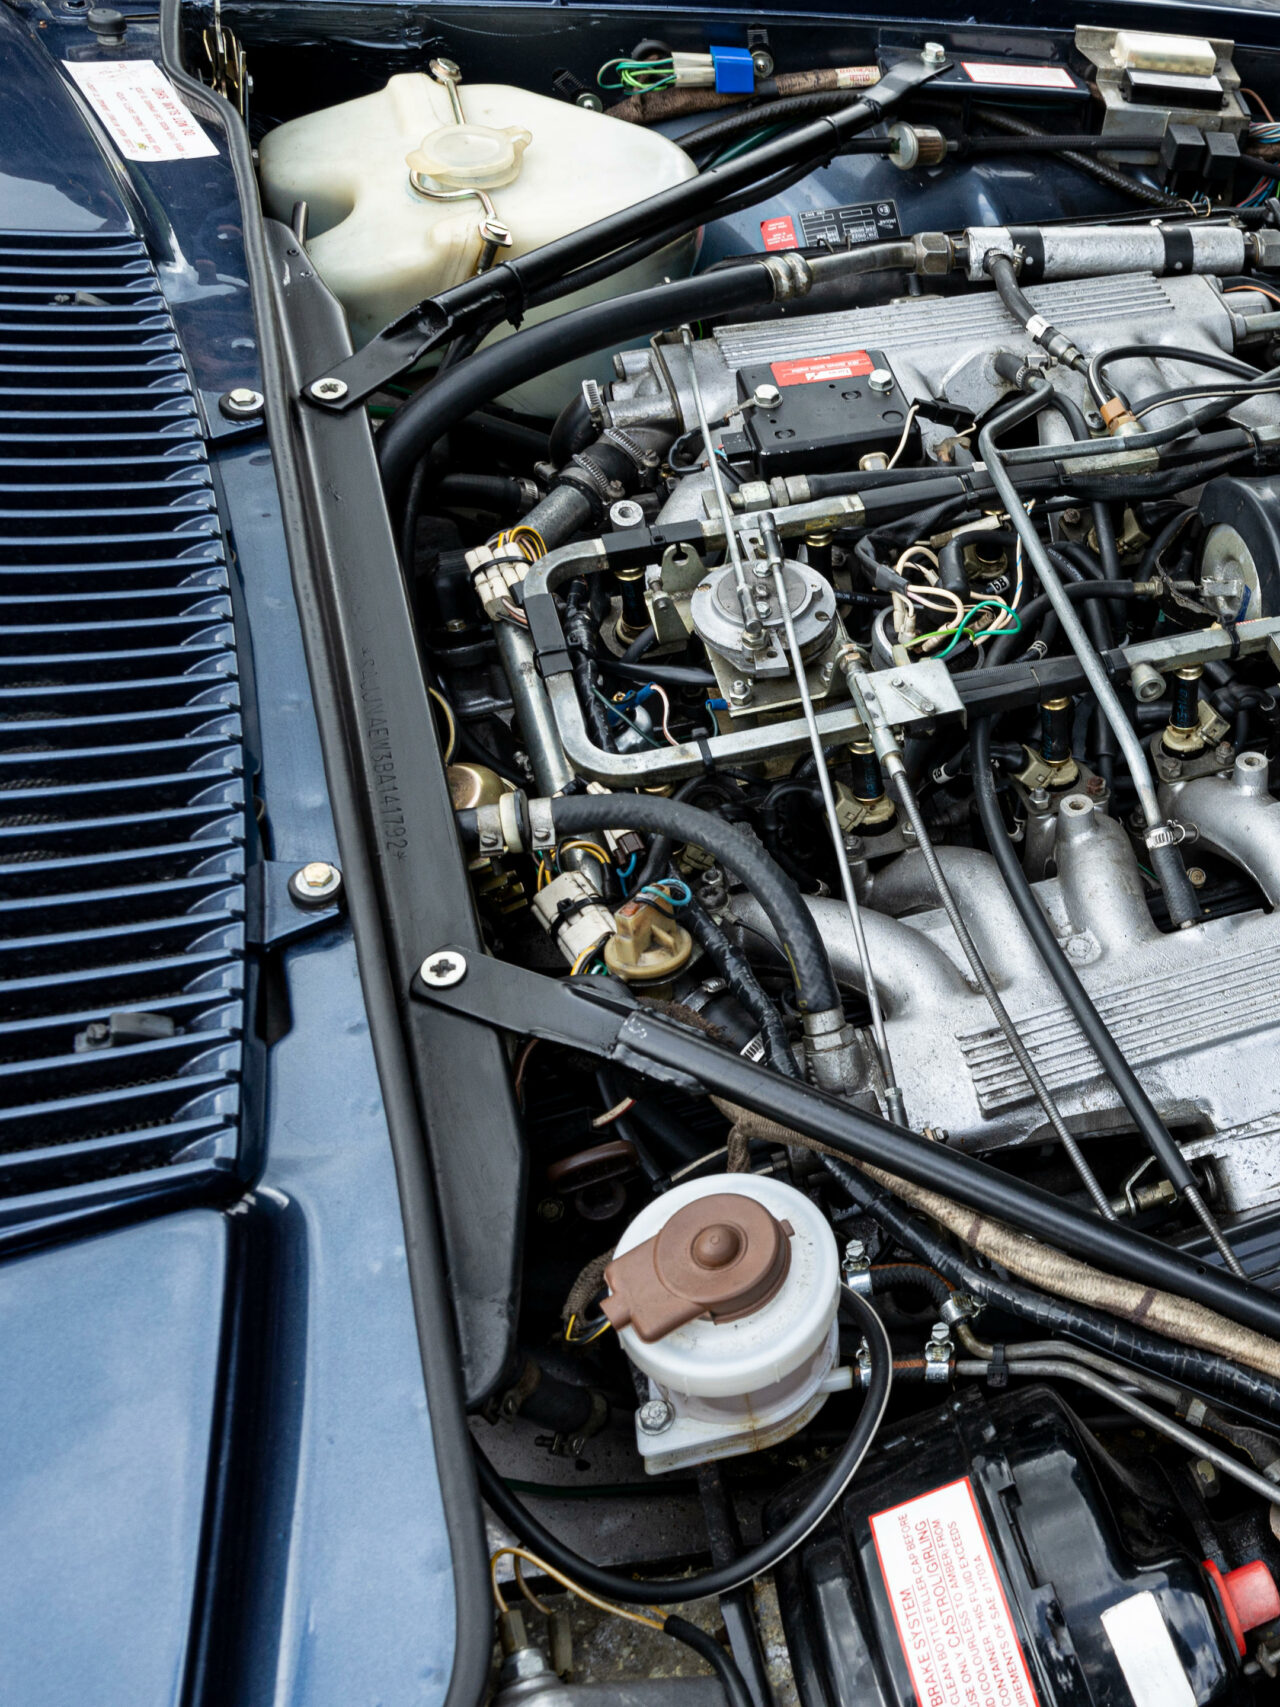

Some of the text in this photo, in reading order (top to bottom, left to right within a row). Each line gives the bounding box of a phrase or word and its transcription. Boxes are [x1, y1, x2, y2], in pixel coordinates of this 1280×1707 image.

[931, 1518, 947, 1547] FROM
[947, 1520, 969, 1568] EXCEEDS
[913, 1519, 961, 1648] CASTROL/GIRLING
[953, 1591, 965, 1607] TO
[962, 1570, 979, 1602] FLUID
[897, 1513, 960, 1706] CLEAN BOTTLE FILLER CAP BEFORE
[972, 1603, 988, 1629] THIS
[973, 1554, 1029, 1707] UIREMENTS OF SAE J1703A
[898, 1587, 943, 1707] BRAKE SYSTEM
[954, 1650, 972, 1683] ONLY
[958, 1609, 992, 1695] (COLOURLESS
